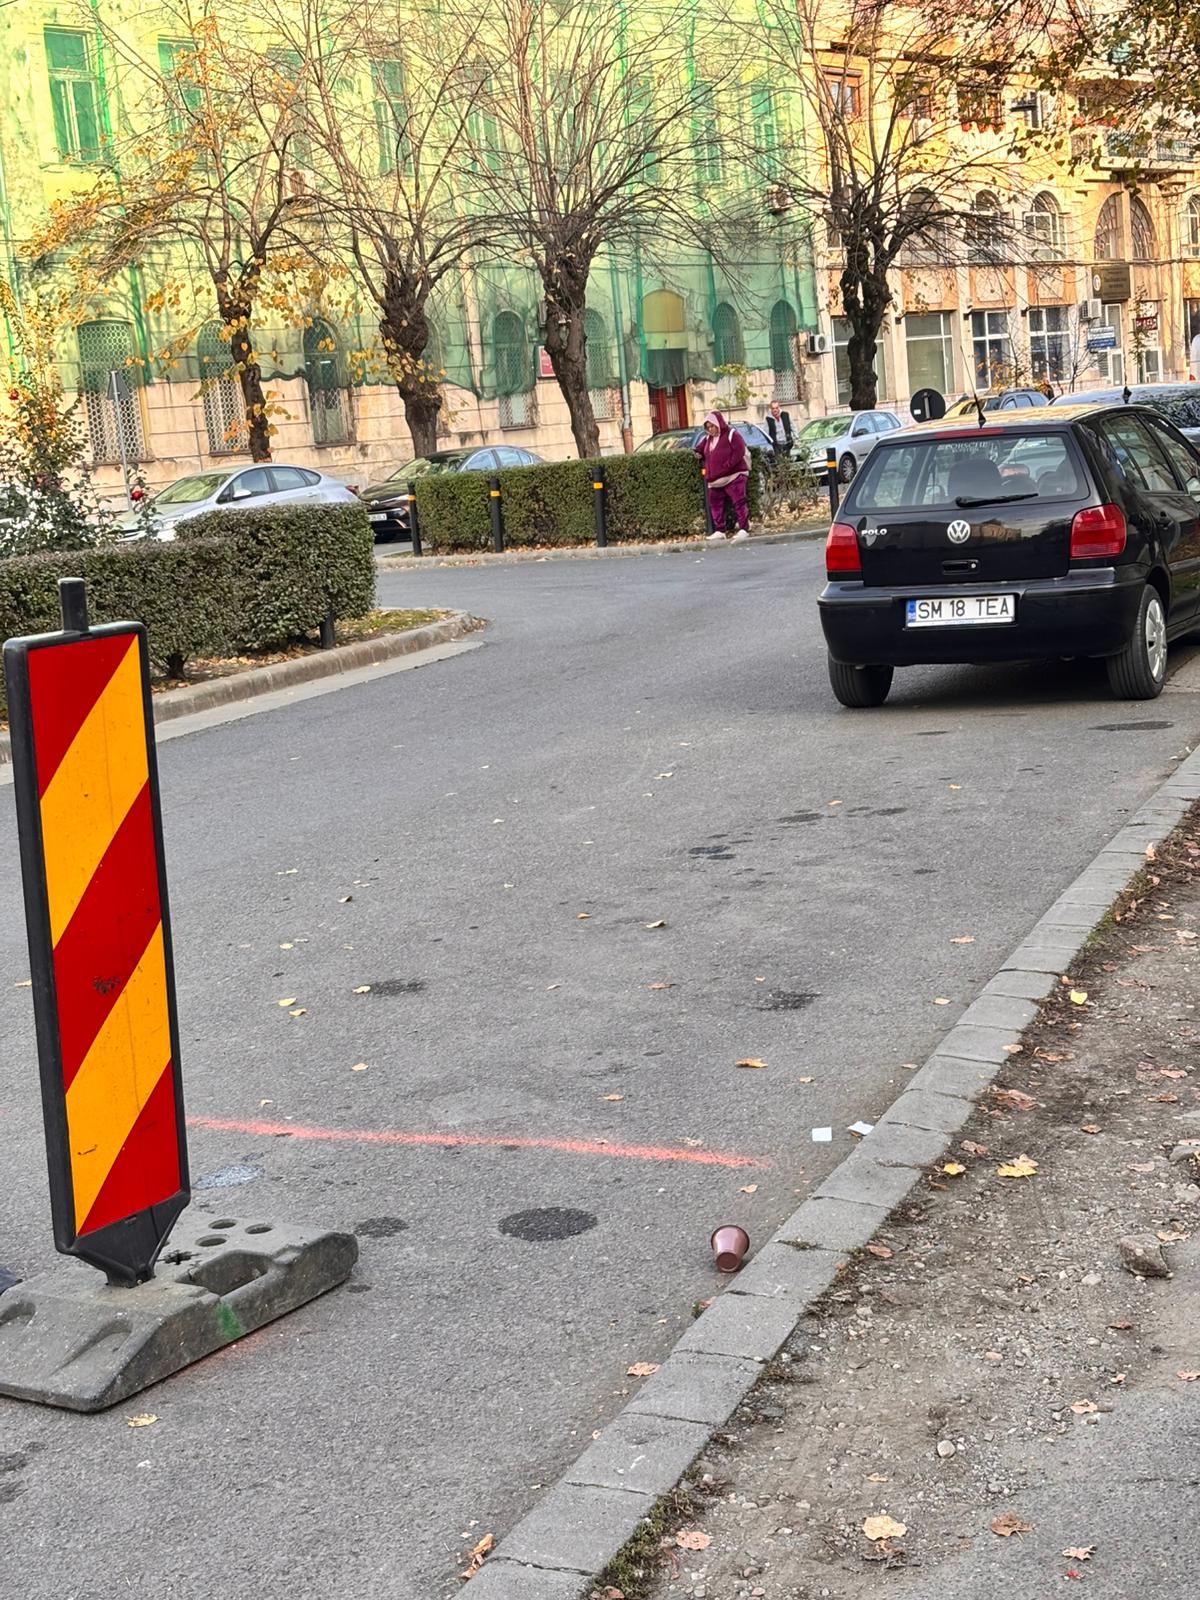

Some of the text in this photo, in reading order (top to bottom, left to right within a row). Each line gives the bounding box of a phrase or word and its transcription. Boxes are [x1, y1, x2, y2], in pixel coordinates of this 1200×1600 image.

[861, 528, 888, 536] POLO
[918, 597, 1009, 619] SM 18 TEA
